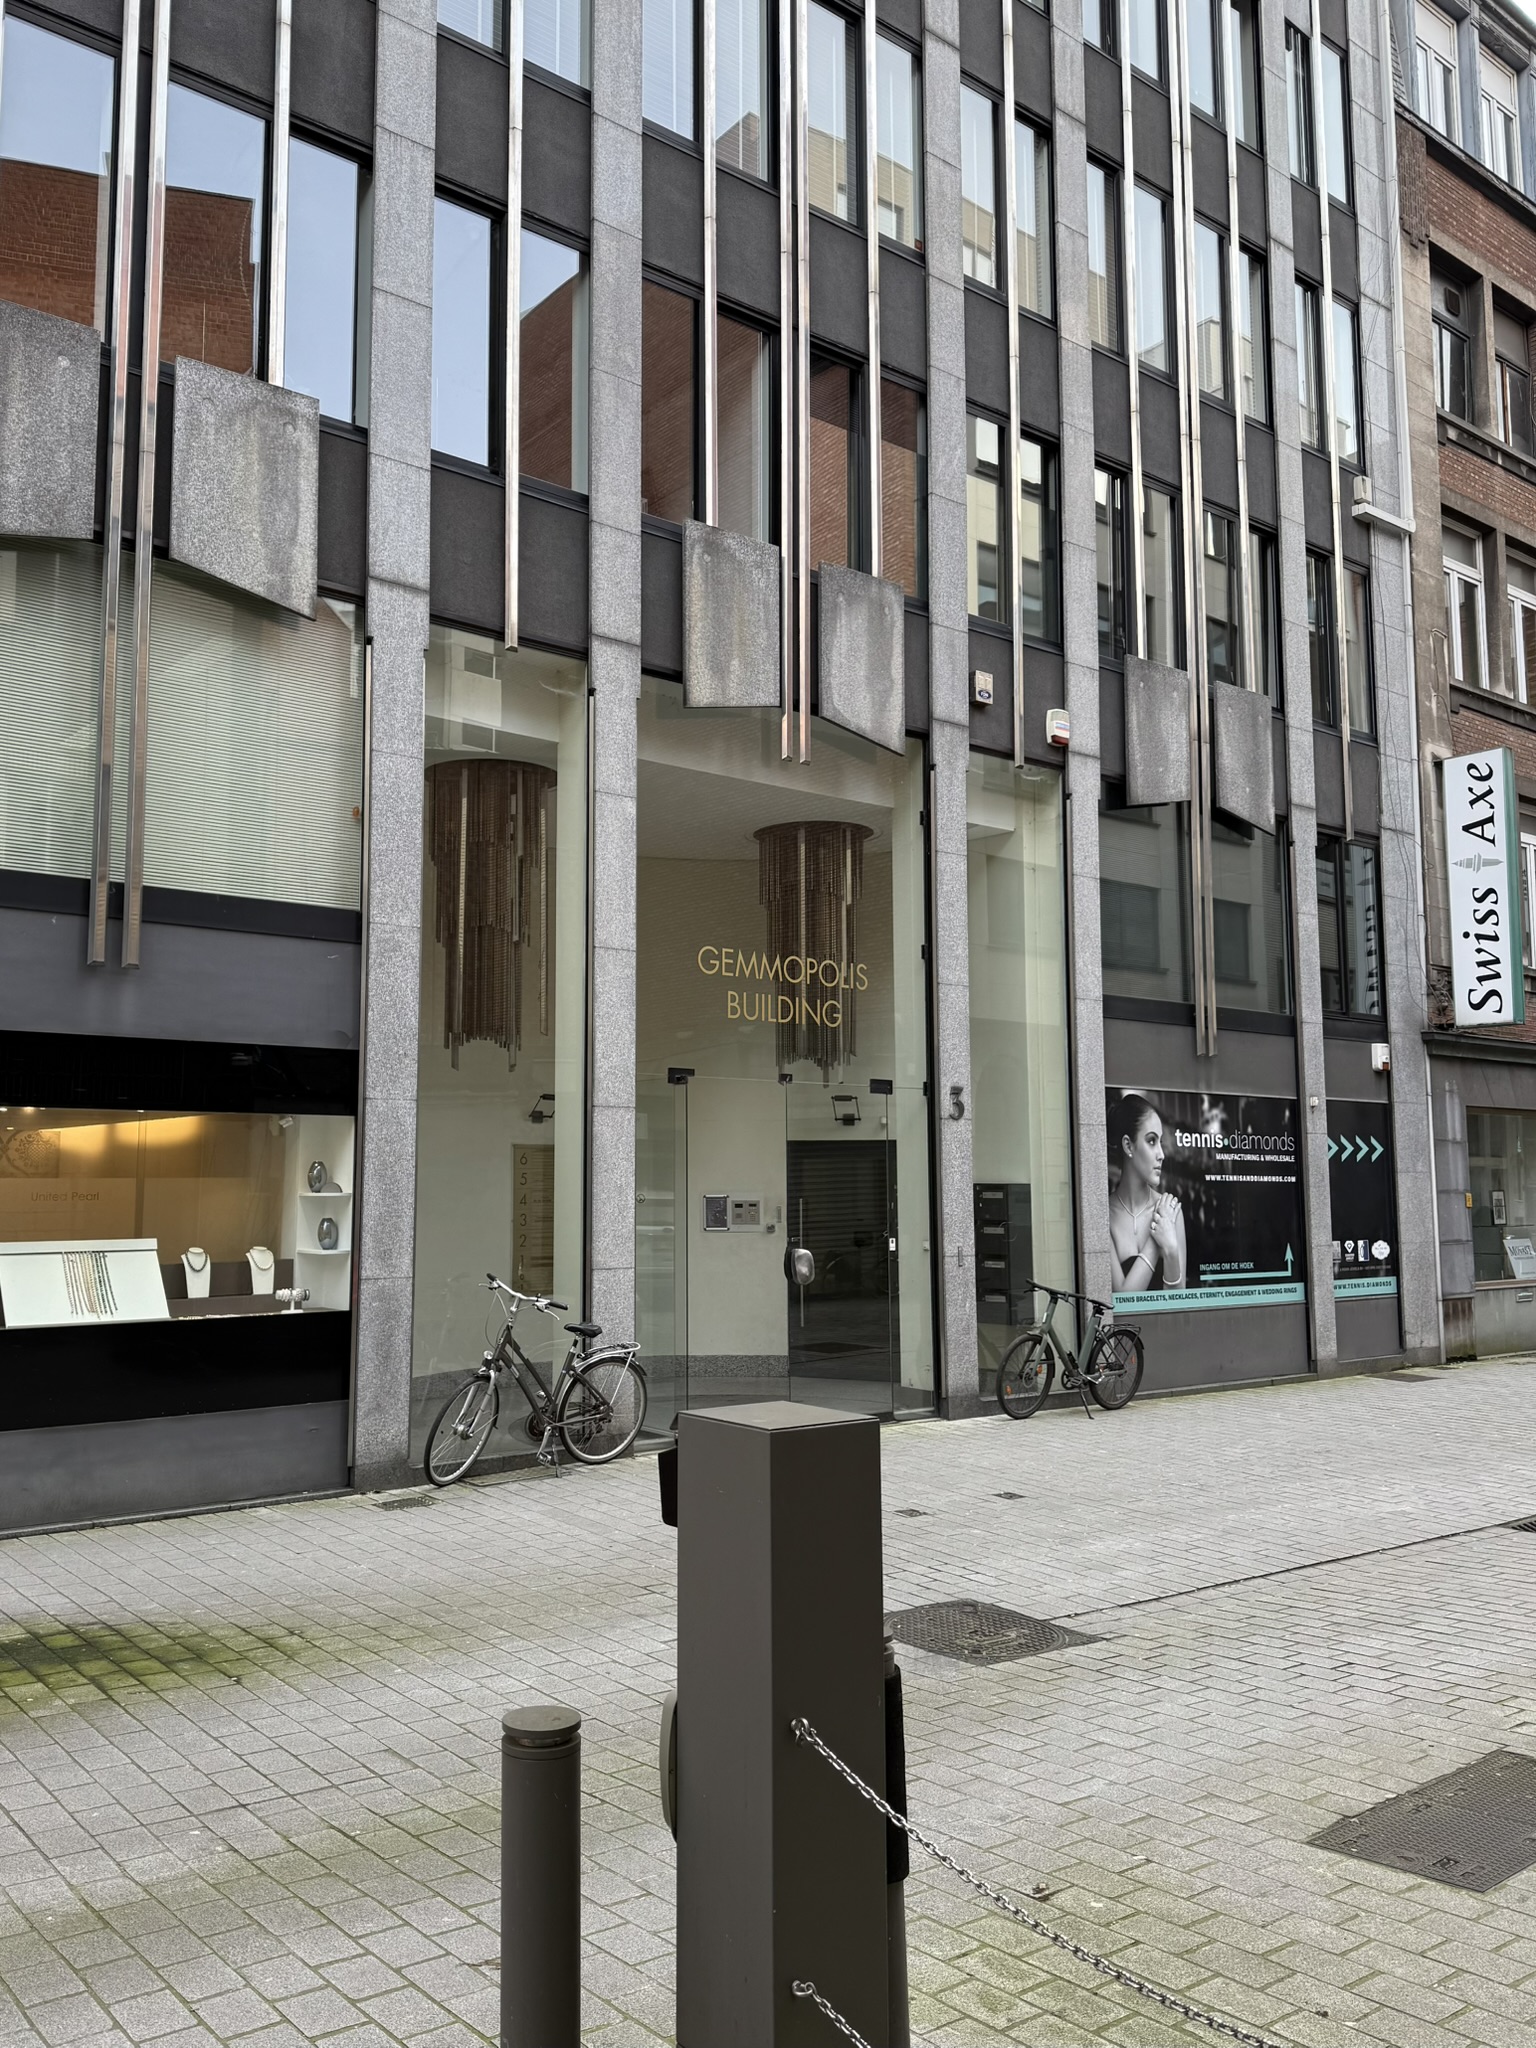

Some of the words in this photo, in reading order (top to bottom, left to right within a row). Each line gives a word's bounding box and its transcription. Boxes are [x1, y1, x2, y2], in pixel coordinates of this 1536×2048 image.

[1462, 763, 1496, 847] Axe
[1463, 887, 1502, 1013] Swiss
[697, 945, 868, 991] GEMMOPOLIS
[727, 990, 843, 1028] BUILDING
[949, 1086, 965, 1120] 3
[519, 1152, 528, 1166] 6
[1215, 1152, 1260, 1161] MANUFACTURING
[1265, 1154, 1296, 1162] WHOLESALE
[519, 1172, 528, 1186] 5
[31, 1191, 68, 1202] United
[71, 1191, 100, 1201] Pearl
[519, 1193, 527, 1207] 4
[519, 1213, 527, 1227] 3
[519, 1234, 527, 1248] 2
[1200, 1263, 1221, 1271] INGANG
[1221, 1262, 1231, 1270] OM
[1231, 1262, 1239, 1270] DE
[1240, 1261, 1255, 1269] HOEK
[1115, 1296, 1135, 1304] TENNIS
[1135, 1294, 1167, 1303] BRACELETS,
[1168, 1292, 1199, 1301] NECKLACES,
[1199, 1290, 1225, 1299] ETERNITY,
[1225, 1289, 1257, 1298] ENGAGEMENT
[1283, 1286, 1297, 1294] RINGS
